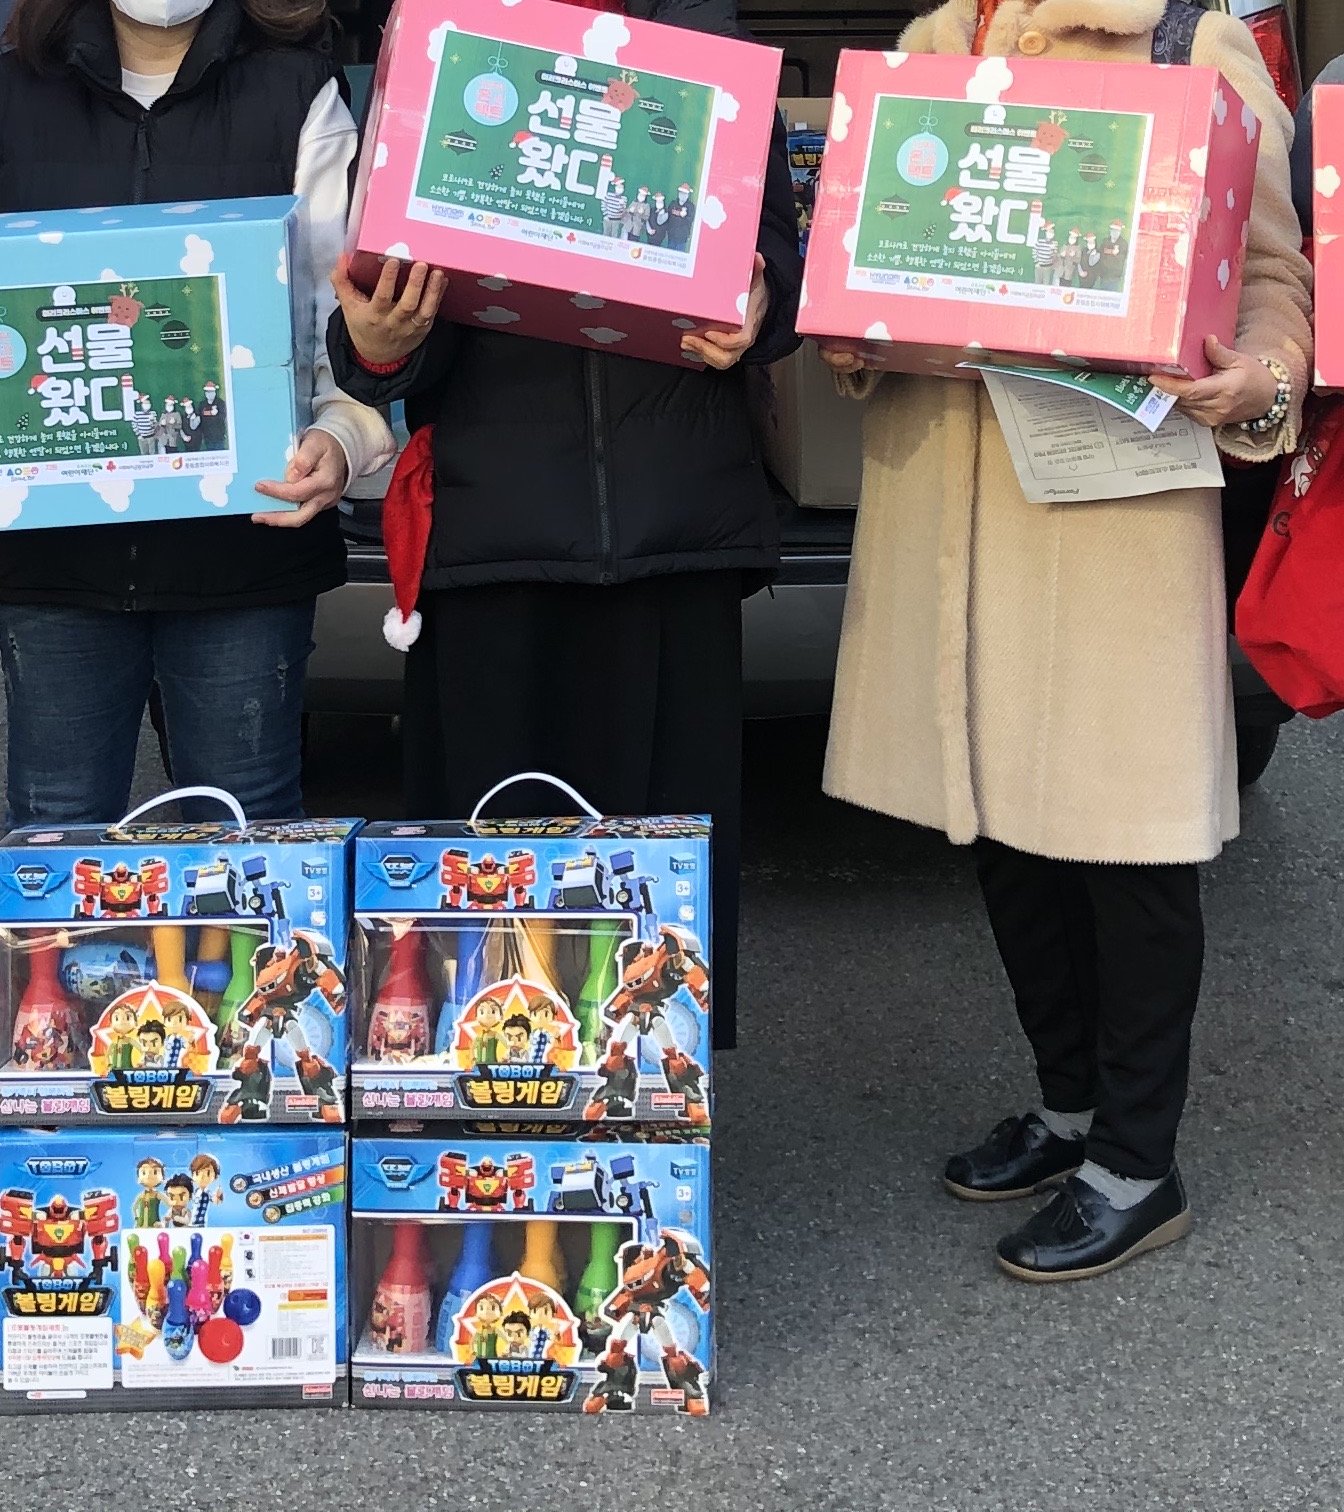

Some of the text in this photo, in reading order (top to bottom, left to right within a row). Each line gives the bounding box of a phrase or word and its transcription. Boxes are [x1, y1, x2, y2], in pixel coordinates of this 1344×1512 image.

[528, 90, 621, 150] 선물
[517, 137, 614, 199] 왔다
[957, 142, 1051, 194] 선물
[949, 191, 1045, 247] 왔다
[35, 320, 134, 375] 선물
[38, 369, 140, 427] 왔다
[6, 432, 37, 444] 건강하게
[79, 426, 116, 440] 아이들에게
[3, 447, 27, 460] 행복한
[309, 888, 322, 898] 3+
[676, 883, 690, 894] 3+
[125, 1070, 180, 1082] TOBOT
[488, 1065, 544, 1078] TOBOT
[106, 1085, 199, 1109] 볼링게임
[362, 1092, 454, 1108] 신나는 볼링게임
[469, 1079, 563, 1105] 볼링게임
[0, 1098, 90, 1114] 신나는 볼링게임
[29, 1160, 88, 1174] TOBOT
[32, 1279, 83, 1289] TOBOT
[13, 1292, 100, 1313] 볼링게임
[487, 1360, 544, 1373] TOBOT
[362, 1384, 401, 1399] 신나는
[467, 1373, 563, 1398] 볼링게임
